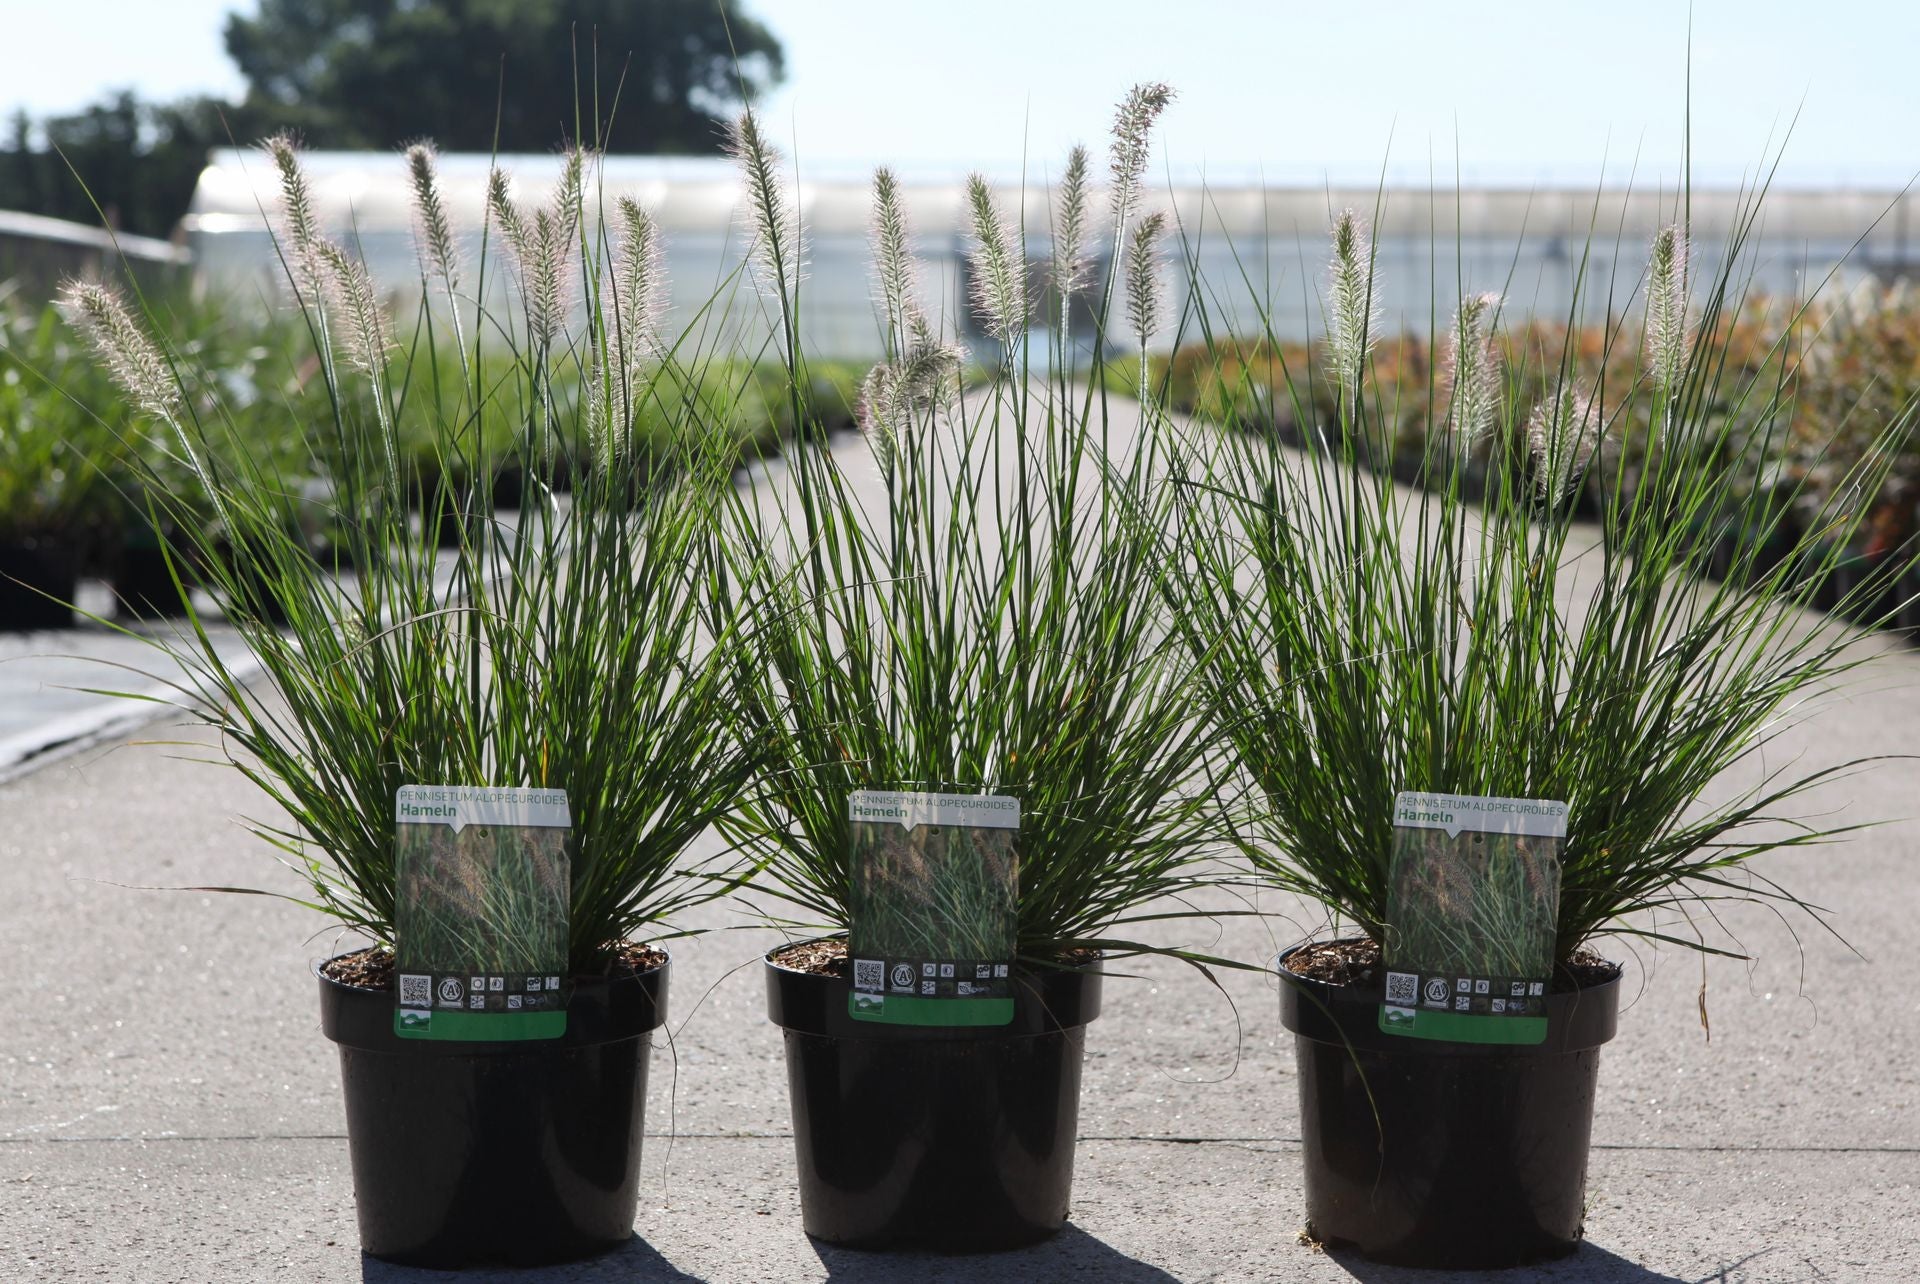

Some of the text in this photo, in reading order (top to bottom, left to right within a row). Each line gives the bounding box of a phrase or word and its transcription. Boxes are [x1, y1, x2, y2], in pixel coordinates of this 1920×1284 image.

[401, 790, 566, 805] PENNISETUM ALOPECUROIDES
[853, 795, 1015, 810] PENNISETUM ALOPECUROIDES
[401, 804, 457, 817] Hameln
[853, 805, 908, 818] Hameln
[1400, 796, 1563, 817] PENNISETUM ALOPECUROIDES
[1398, 809, 1453, 823] Hameln
